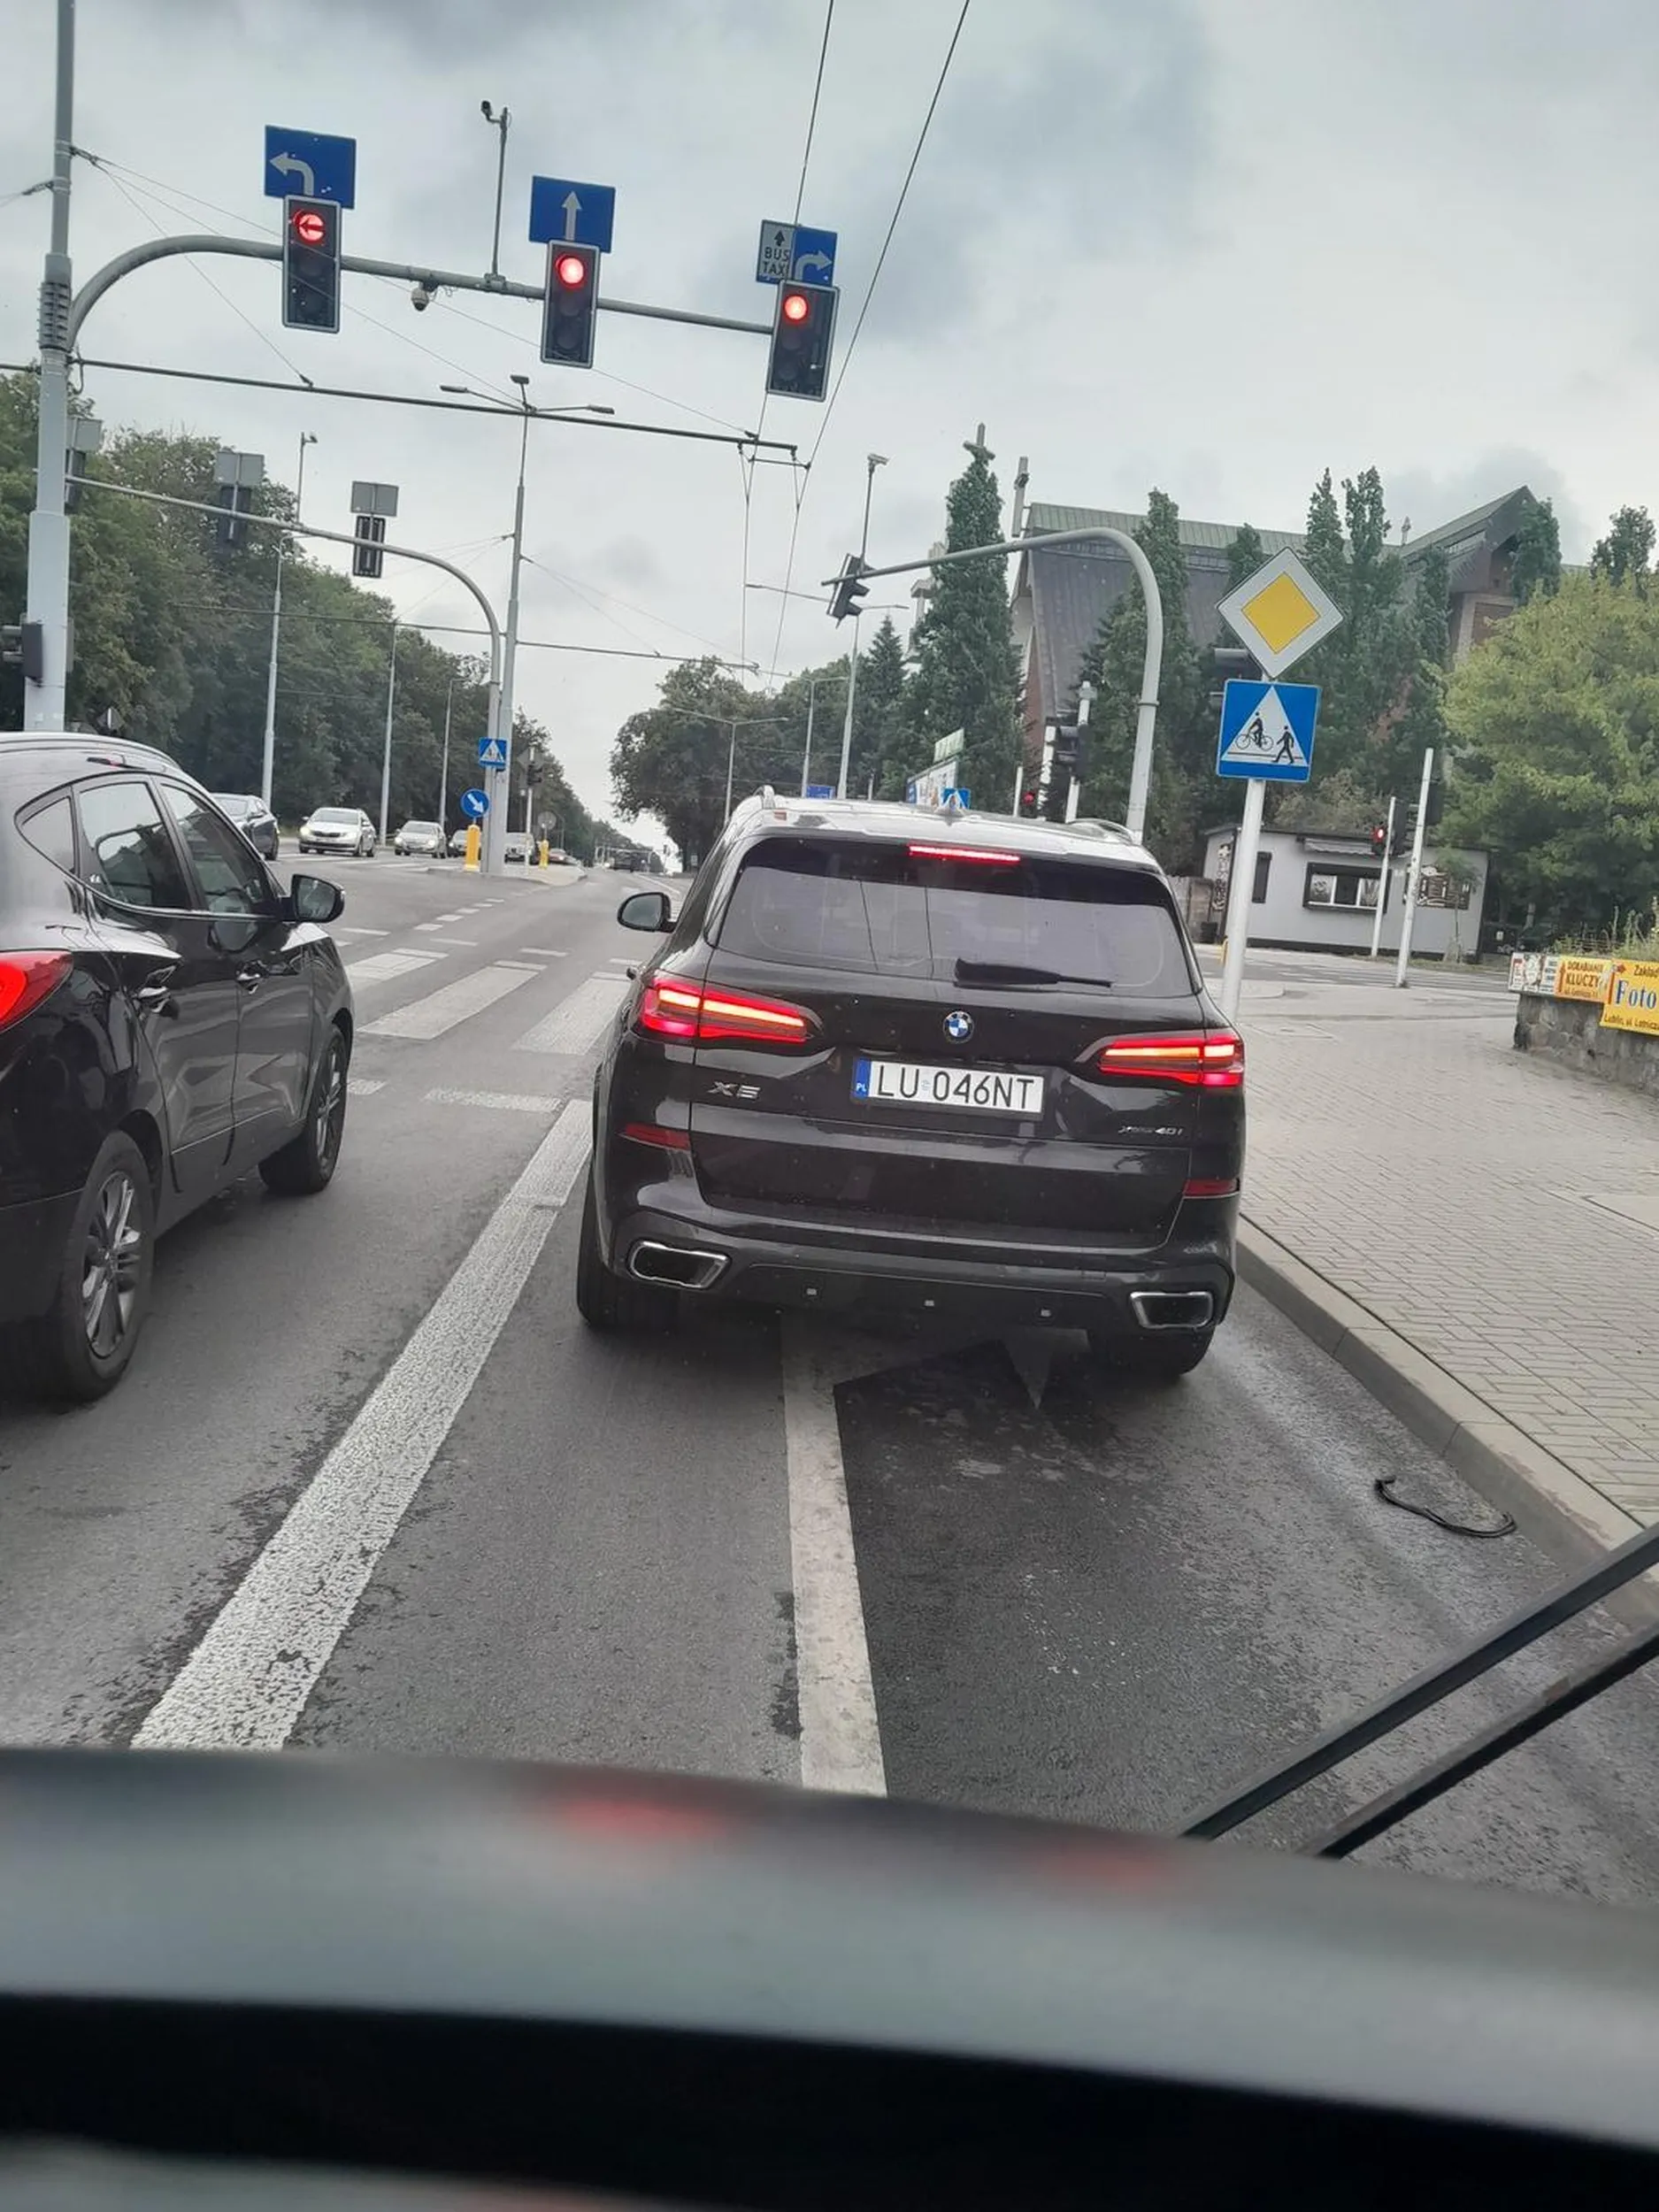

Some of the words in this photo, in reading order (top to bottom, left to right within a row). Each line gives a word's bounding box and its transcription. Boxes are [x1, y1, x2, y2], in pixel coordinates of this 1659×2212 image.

[764, 247, 791, 262] BUS
[763, 261, 789, 278] TAXI
[1566, 972, 1600, 987] KLUCZY
[1616, 979, 1656, 1009] Foto
[707, 1081, 761, 1099] X5
[856, 1083, 867, 1092] PL
[877, 1064, 919, 1099] LU
[933, 1071, 1033, 1110] 046NT
